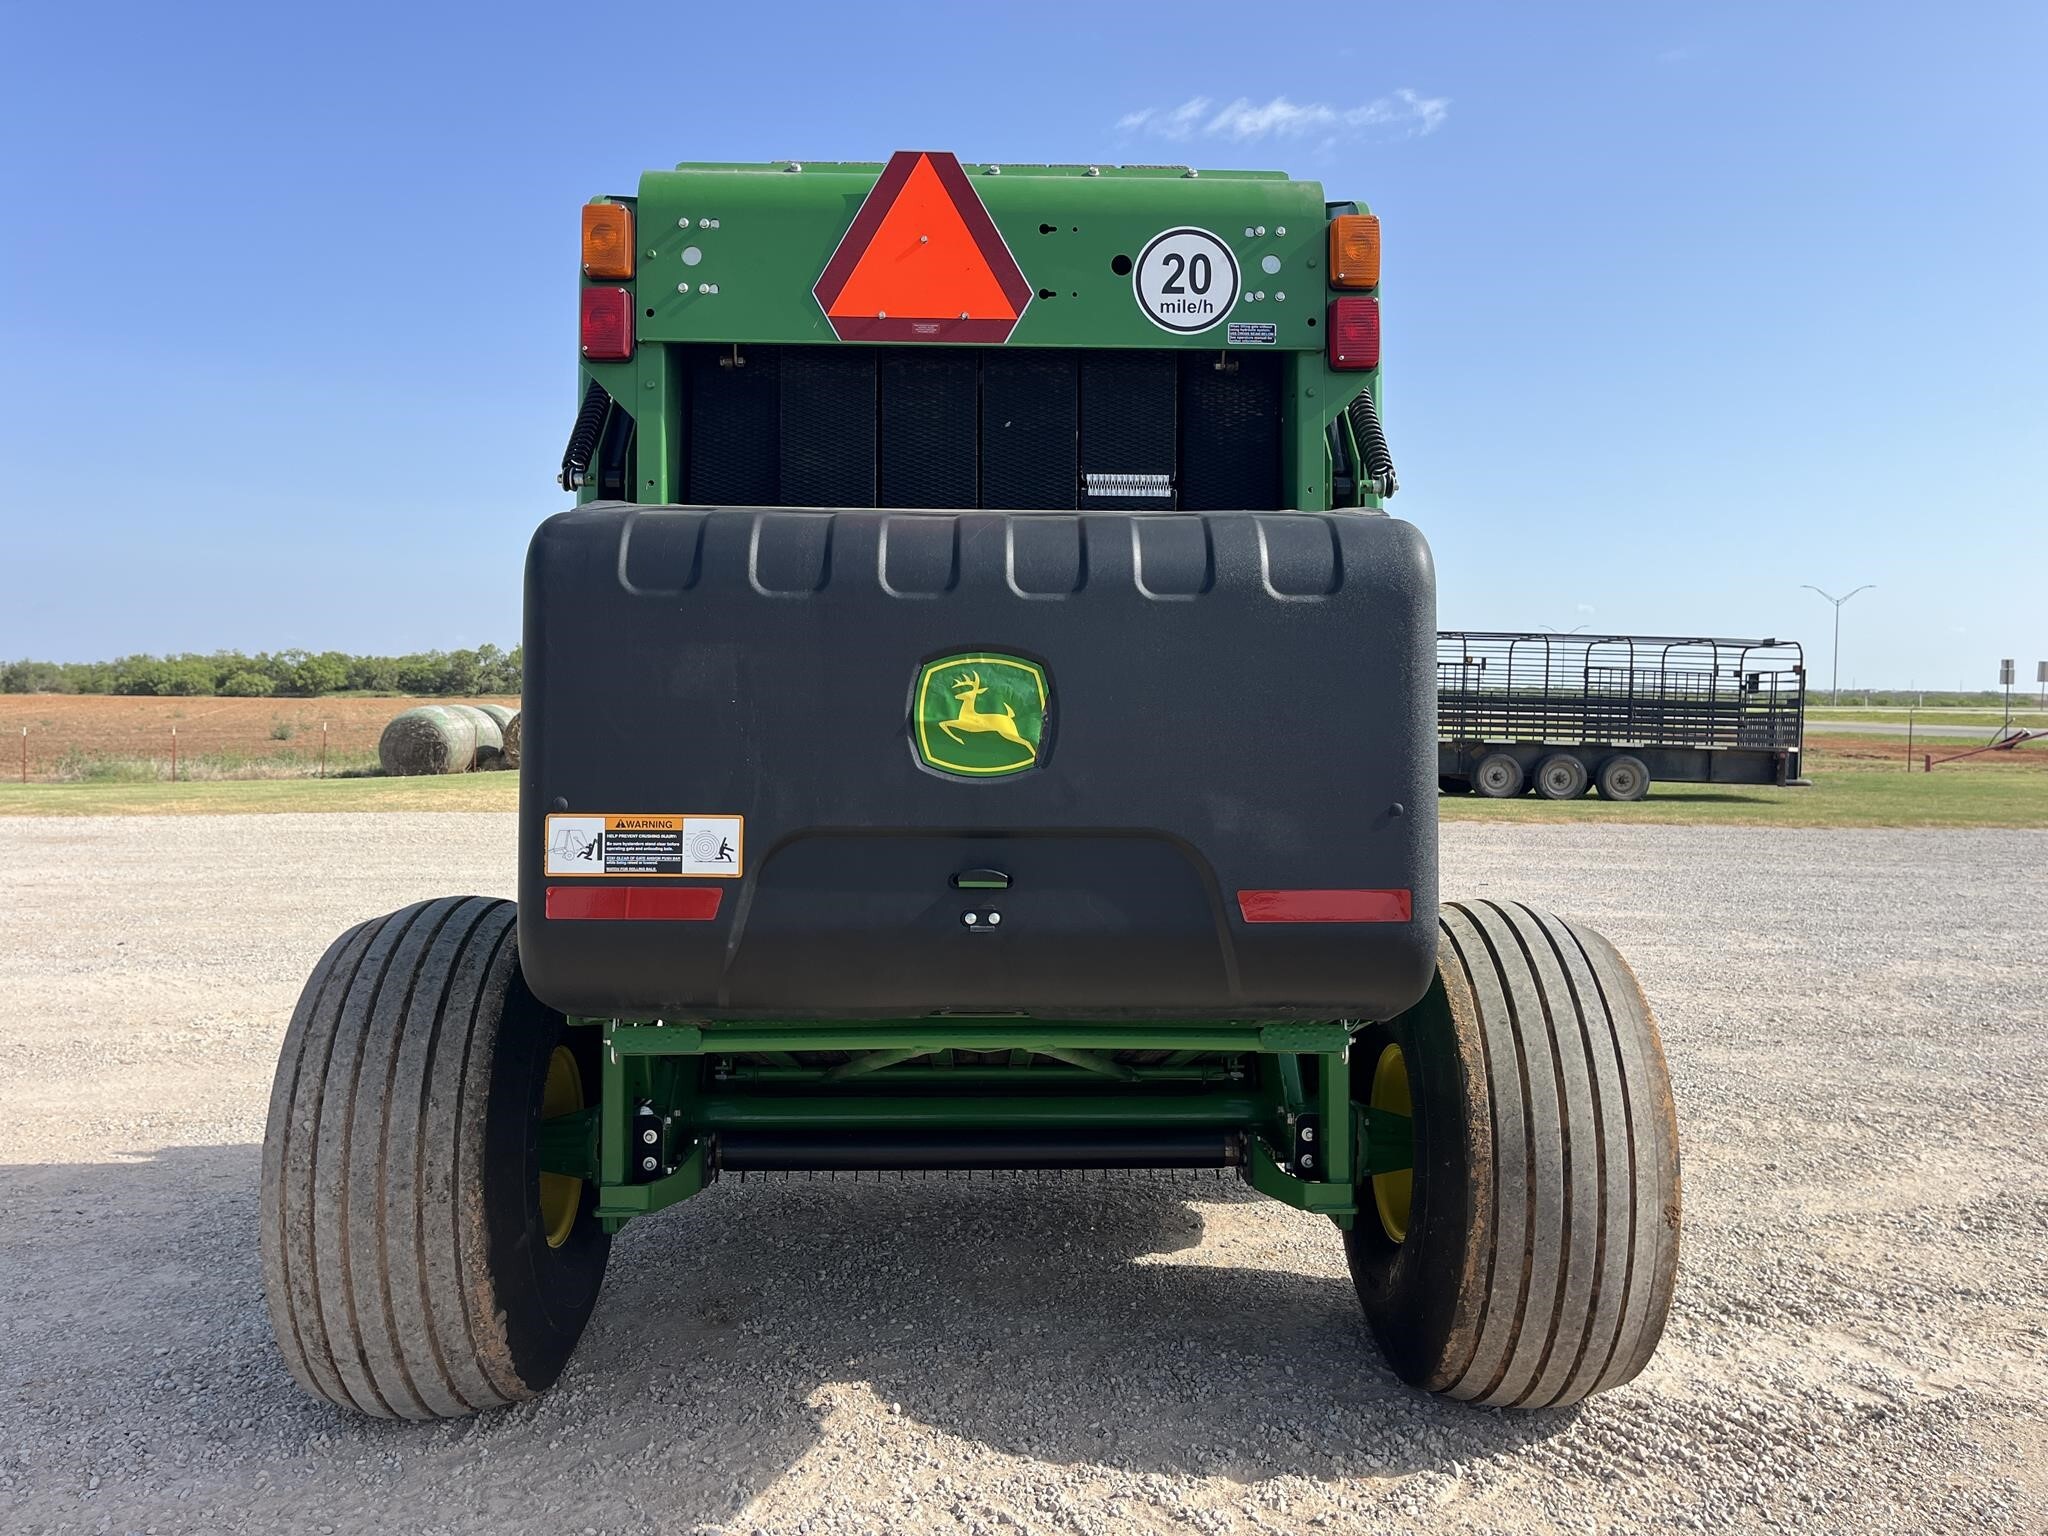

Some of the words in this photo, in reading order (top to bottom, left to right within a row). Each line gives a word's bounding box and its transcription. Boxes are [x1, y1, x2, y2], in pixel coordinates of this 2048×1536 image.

[1161, 252, 1212, 295] 20
[1160, 299, 1214, 314] mile/h
[626, 820, 672, 828] WARNING
